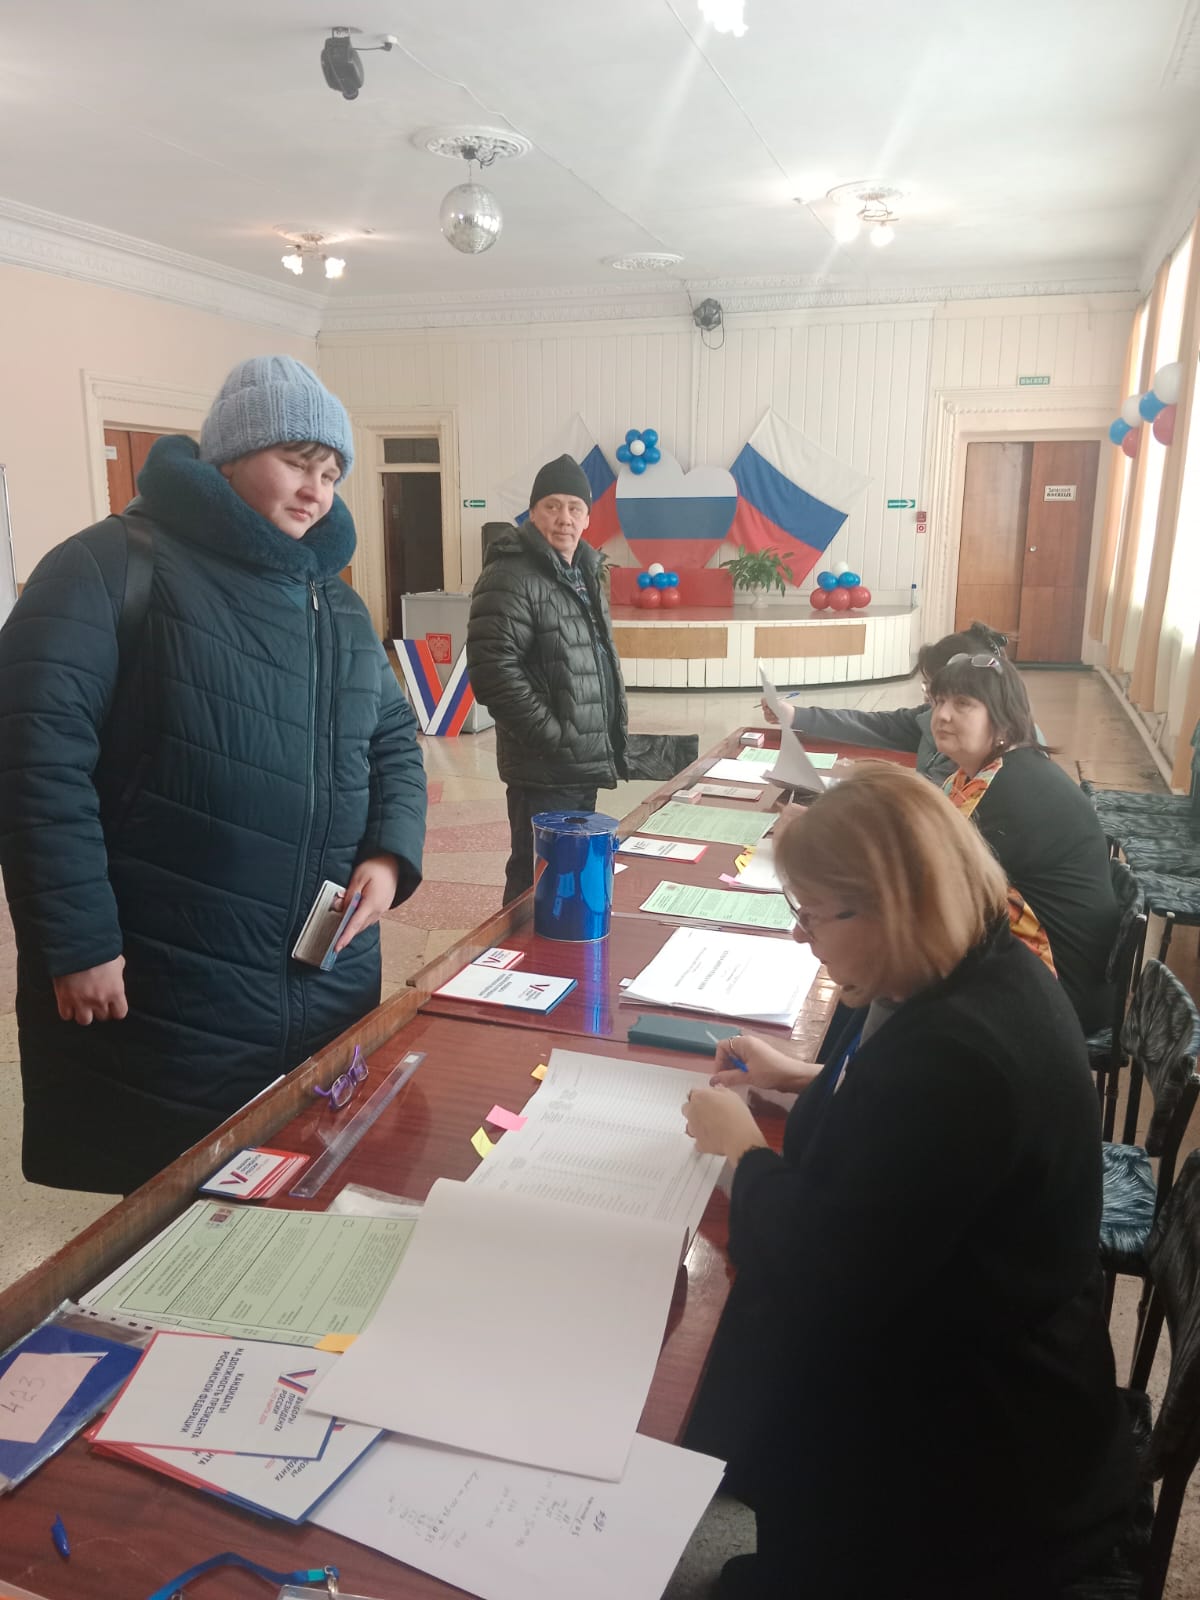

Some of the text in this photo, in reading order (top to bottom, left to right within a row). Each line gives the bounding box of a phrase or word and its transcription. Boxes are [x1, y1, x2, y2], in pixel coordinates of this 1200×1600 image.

[1020, 376, 1049, 385] ВЫХОД
[233, 1348, 244, 1356] НА
[203, 1351, 230, 1392] РОССИЙСКОЙ
[213, 1356, 240, 1396] ДОЛЖНОСТЬ
[0, 1375, 46, 1414] 423
[219, 1373, 244, 1413] КАНДИДАТЫ
[272, 1389, 287, 1414] РОССИИ
[273, 1393, 296, 1431] ПРЕЗИДЕНТА
[287, 1396, 304, 1424] ВЫБОРЫ
[180, 1393, 208, 1433] ФЕДЕРАЦИИ
[191, 1397, 219, 1438] ПРЕЗИДЕНТА
[275, 1459, 299, 1481] ИДЕНТА
[292, 1459, 309, 1478] ОРЫ
